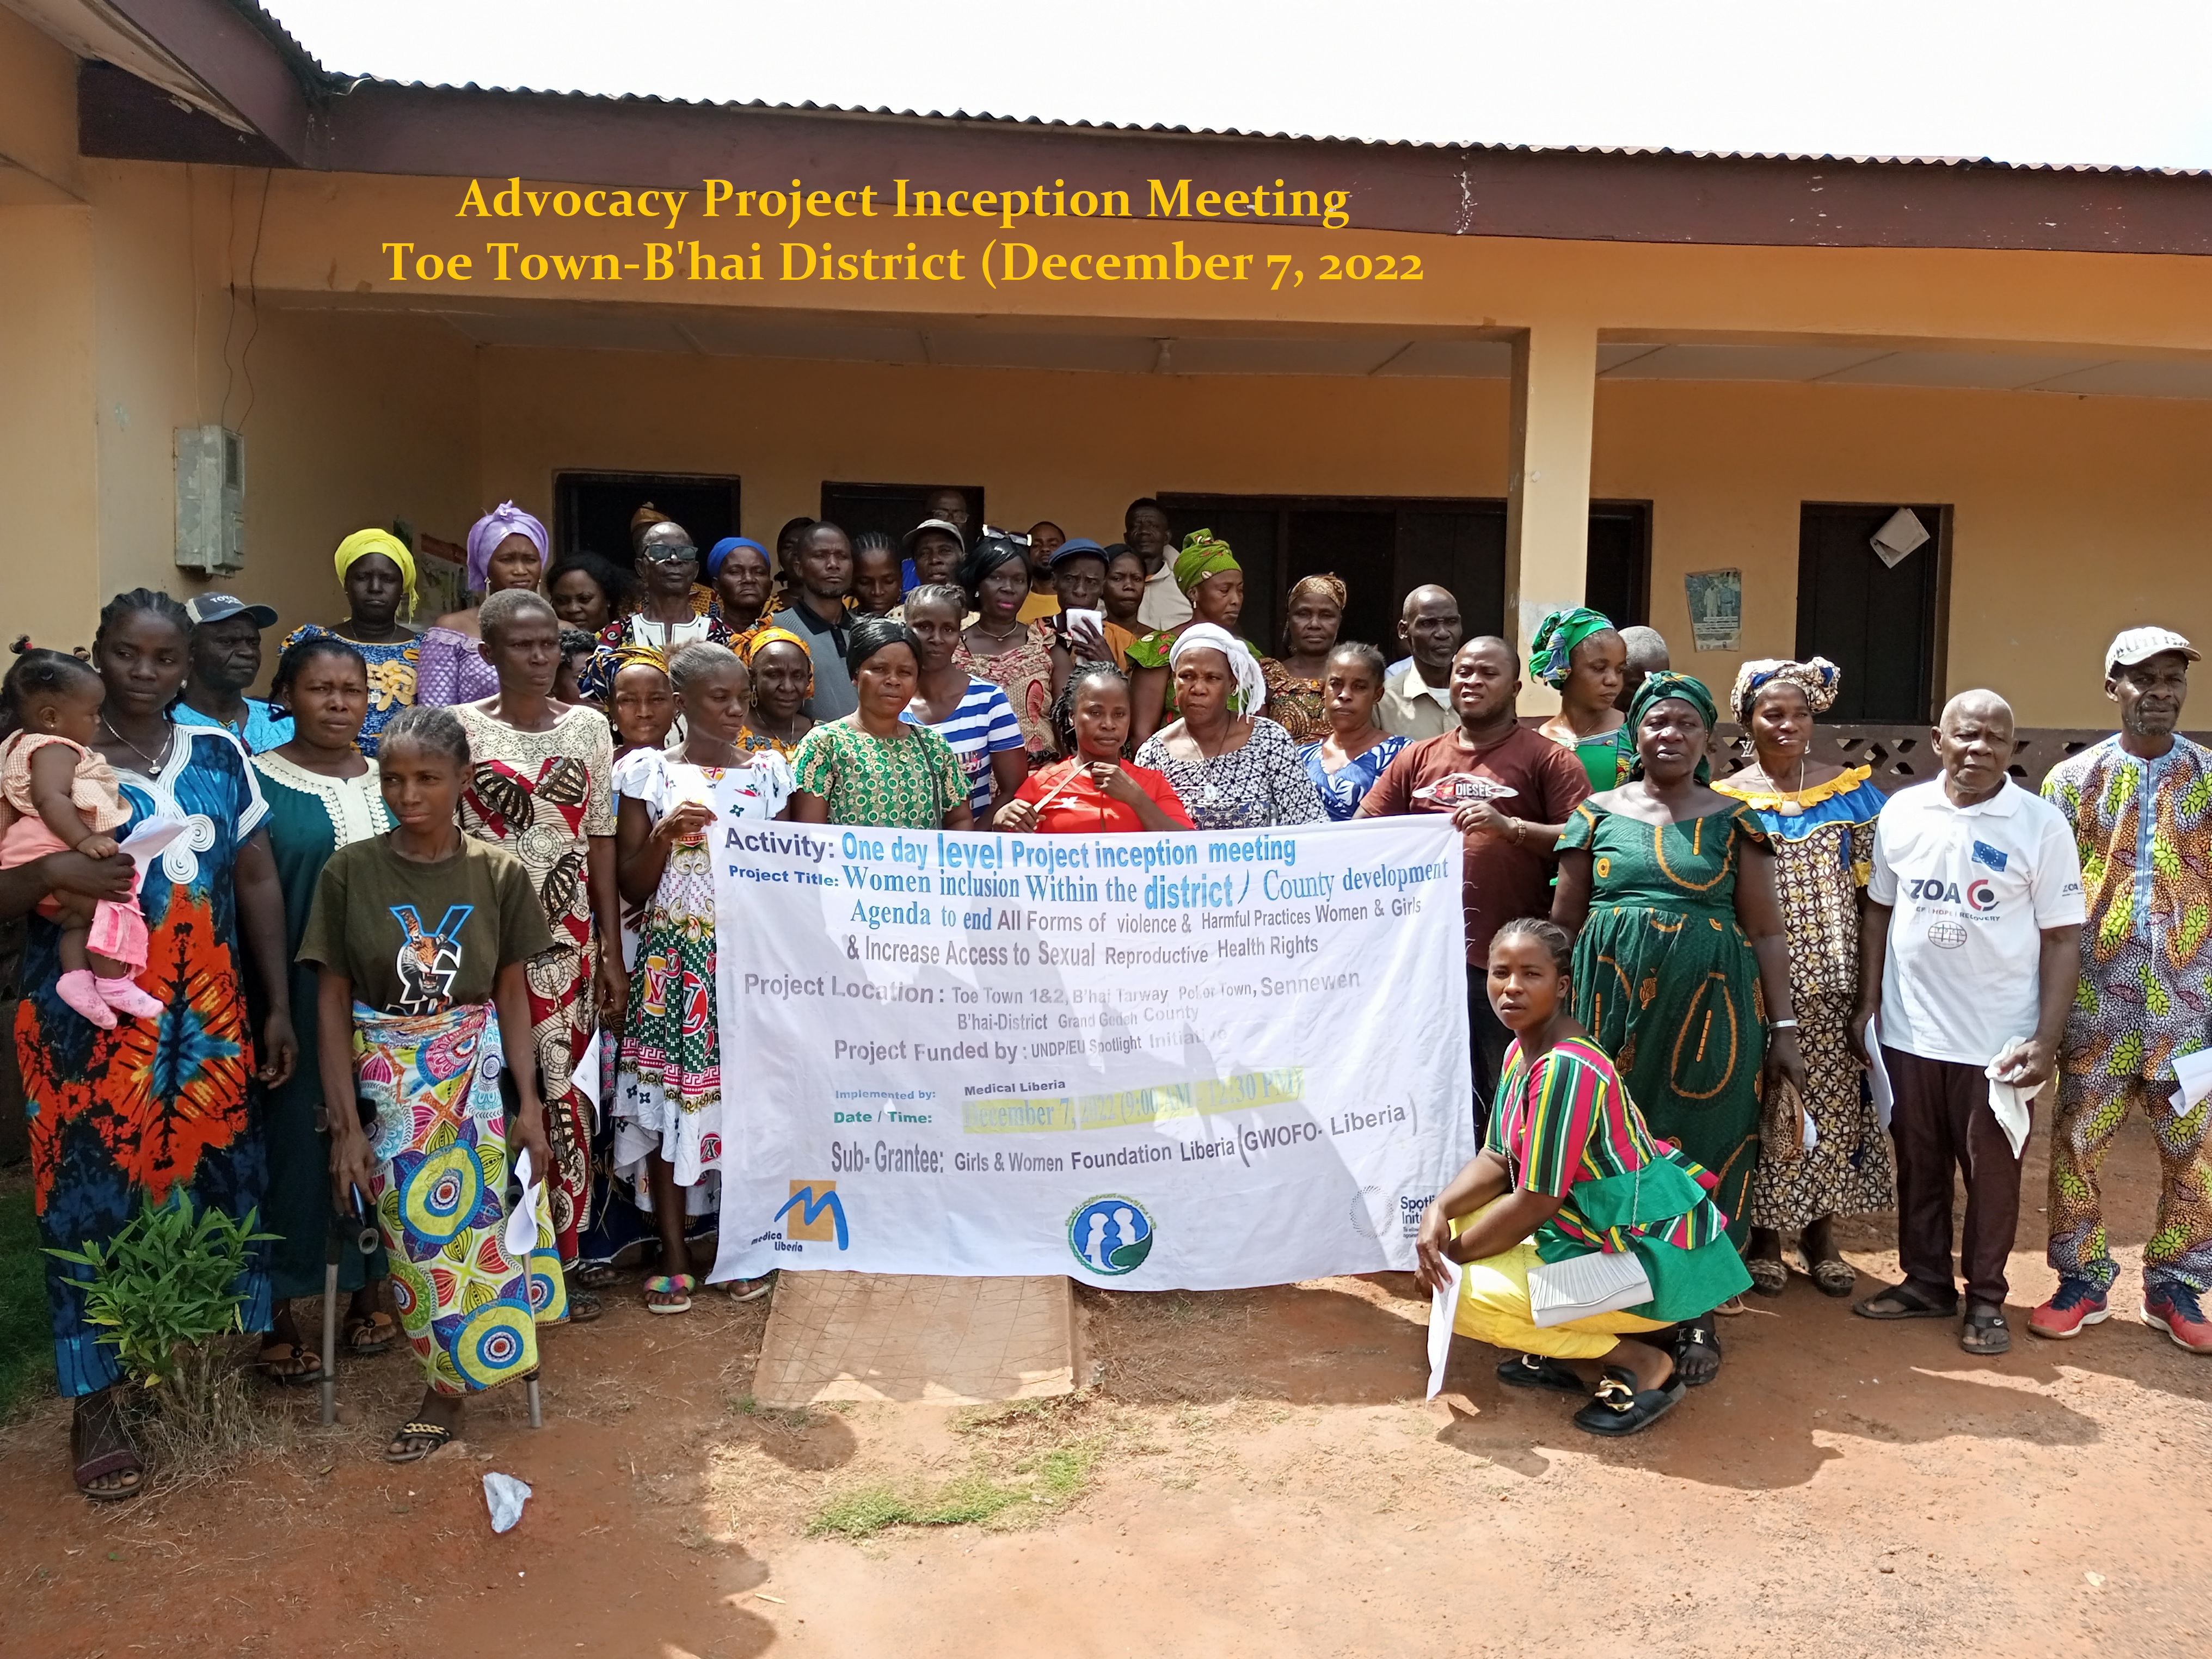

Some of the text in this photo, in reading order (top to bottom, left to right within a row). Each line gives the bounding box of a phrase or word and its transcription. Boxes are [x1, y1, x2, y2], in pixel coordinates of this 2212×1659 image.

[1455, 783, 1491, 797] DIESEL
[725, 827, 834, 863] Activity:
[842, 832, 1295, 874] One day level Project inception meeting
[729, 865, 838, 887] Project Title:
[841, 865, 931, 893] Women
[940, 869, 1019, 898] inclusion
[1024, 875, 1098, 901] Within
[1105, 876, 1137, 902] the
[1263, 870, 1335, 902] County
[1343, 858, 1448, 892] development
[1910, 879, 1961, 904] ZOA
[850, 897, 1421, 933] Agenda to end All Forms of violence & Harmful Practices Women & Girls
[847, 935, 1318, 968] & Increase Access to Sexual Reproductive Health Rights
[745, 974, 824, 1000] Project
[832, 976, 933, 1004] Location
[952, 987, 978, 1003] Toe
[984, 987, 1022, 1004] Town
[1030, 989, 1068, 1005] 1&2,
[1261, 973, 1359, 996] Sennewen
[958, 1013, 1047, 1030] B'hai-District
[1059, 1014, 1094, 1028] Grand
[1145, 1006, 1197, 1021] County
[835, 1040, 906, 1065] Project
[914, 1041, 988, 1061] Funded
[995, 1041, 1017, 1064] by
[1031, 1040, 1085, 1058] UNDP/EU
[1090, 1036, 1141, 1054] Spotlight
[836, 1090, 935, 1100] Implemented by:
[964, 1080, 1065, 1096] Medical Liberia
[834, 1110, 932, 1123] Date / Time:
[963, 1099, 1055, 1128] December
[1059, 1097, 1076, 1129] 7,
[875, 1140, 943, 1173] Grantee:
[955, 1152, 988, 1171] Girls
[994, 1152, 1004, 1171] &
[1009, 1152, 1062, 1171] Women
[1071, 1145, 1171, 1170] Foundation
[1180, 1137, 1235, 1162] Liberia
[751, 1231, 782, 1245] medica
